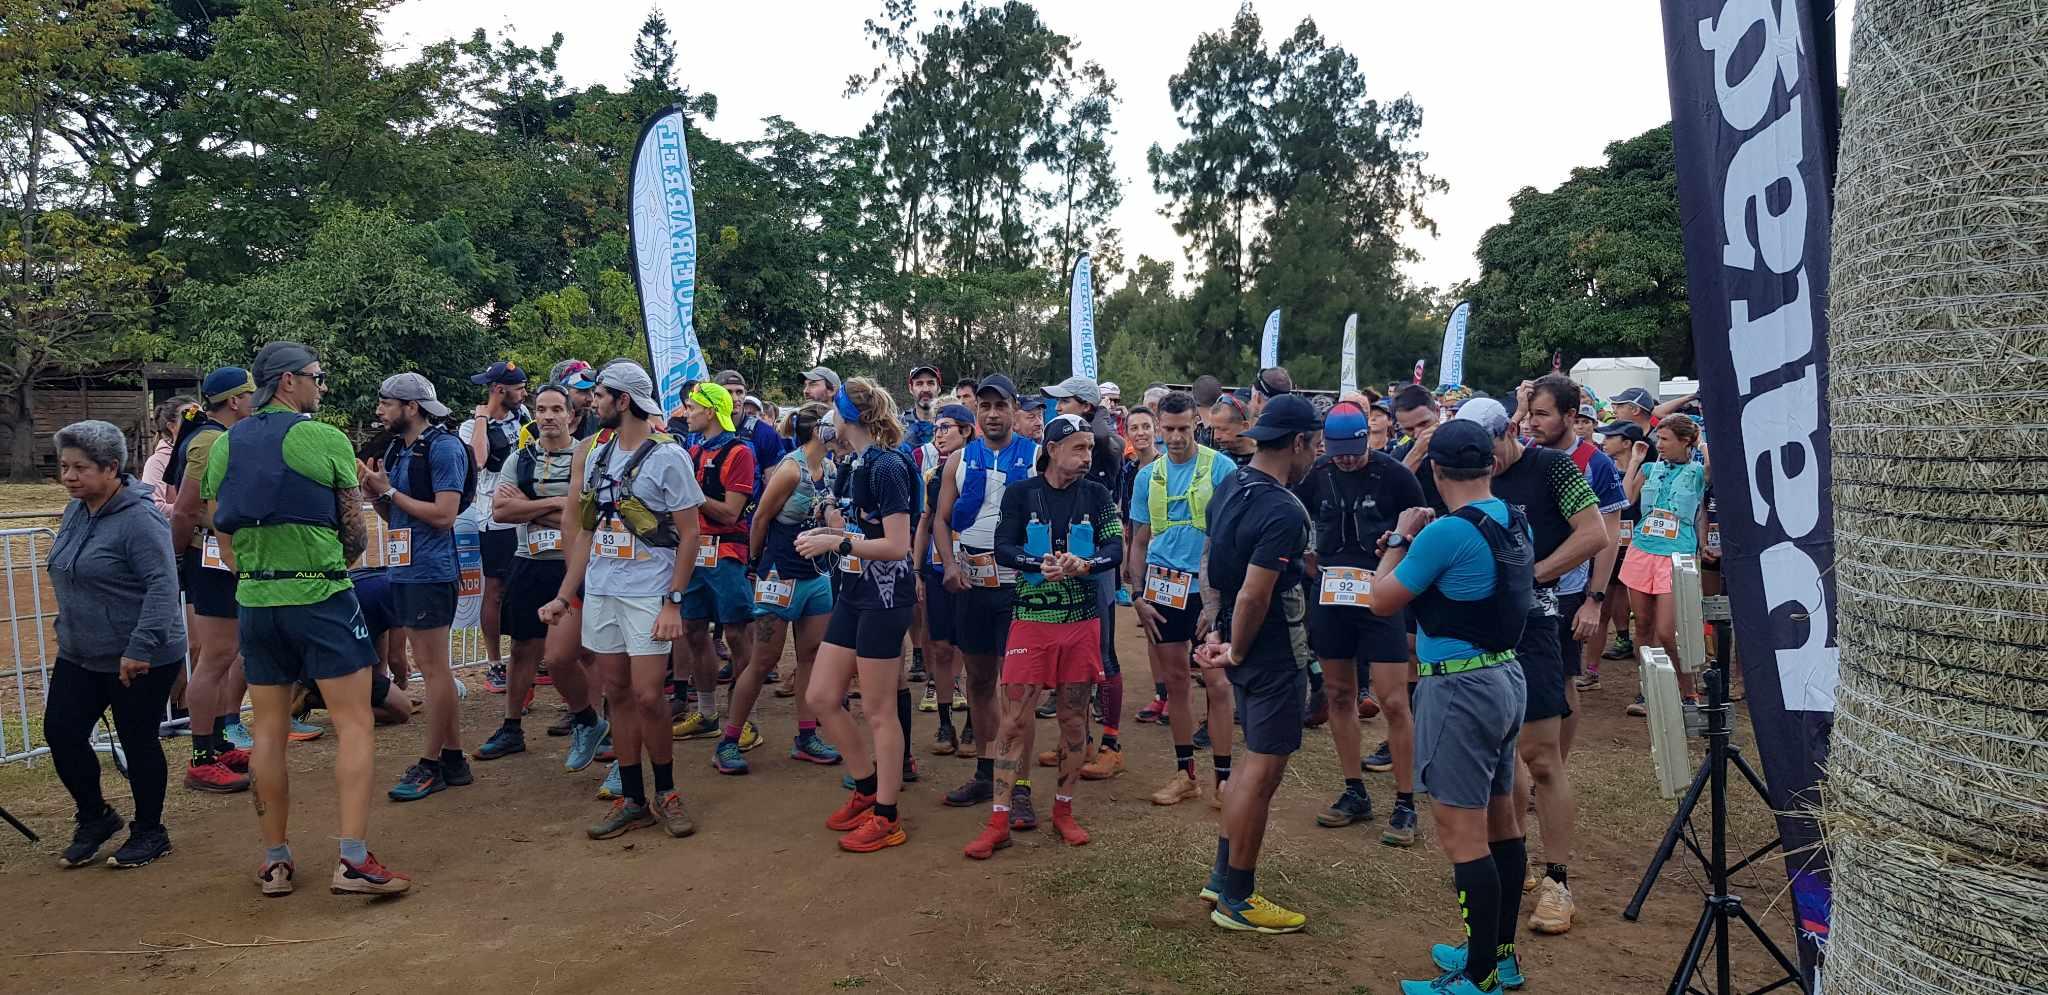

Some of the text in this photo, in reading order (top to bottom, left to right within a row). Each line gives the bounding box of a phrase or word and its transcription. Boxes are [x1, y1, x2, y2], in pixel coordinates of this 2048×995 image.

[1653, 519, 1664, 528] 89
[538, 531, 556, 540] 115
[603, 534, 614, 545] 83
[1709, 533, 1719, 541] 73
[766, 583, 777, 593] 41
[1159, 582, 1170, 593] 21
[1339, 581, 1353, 592] 92
